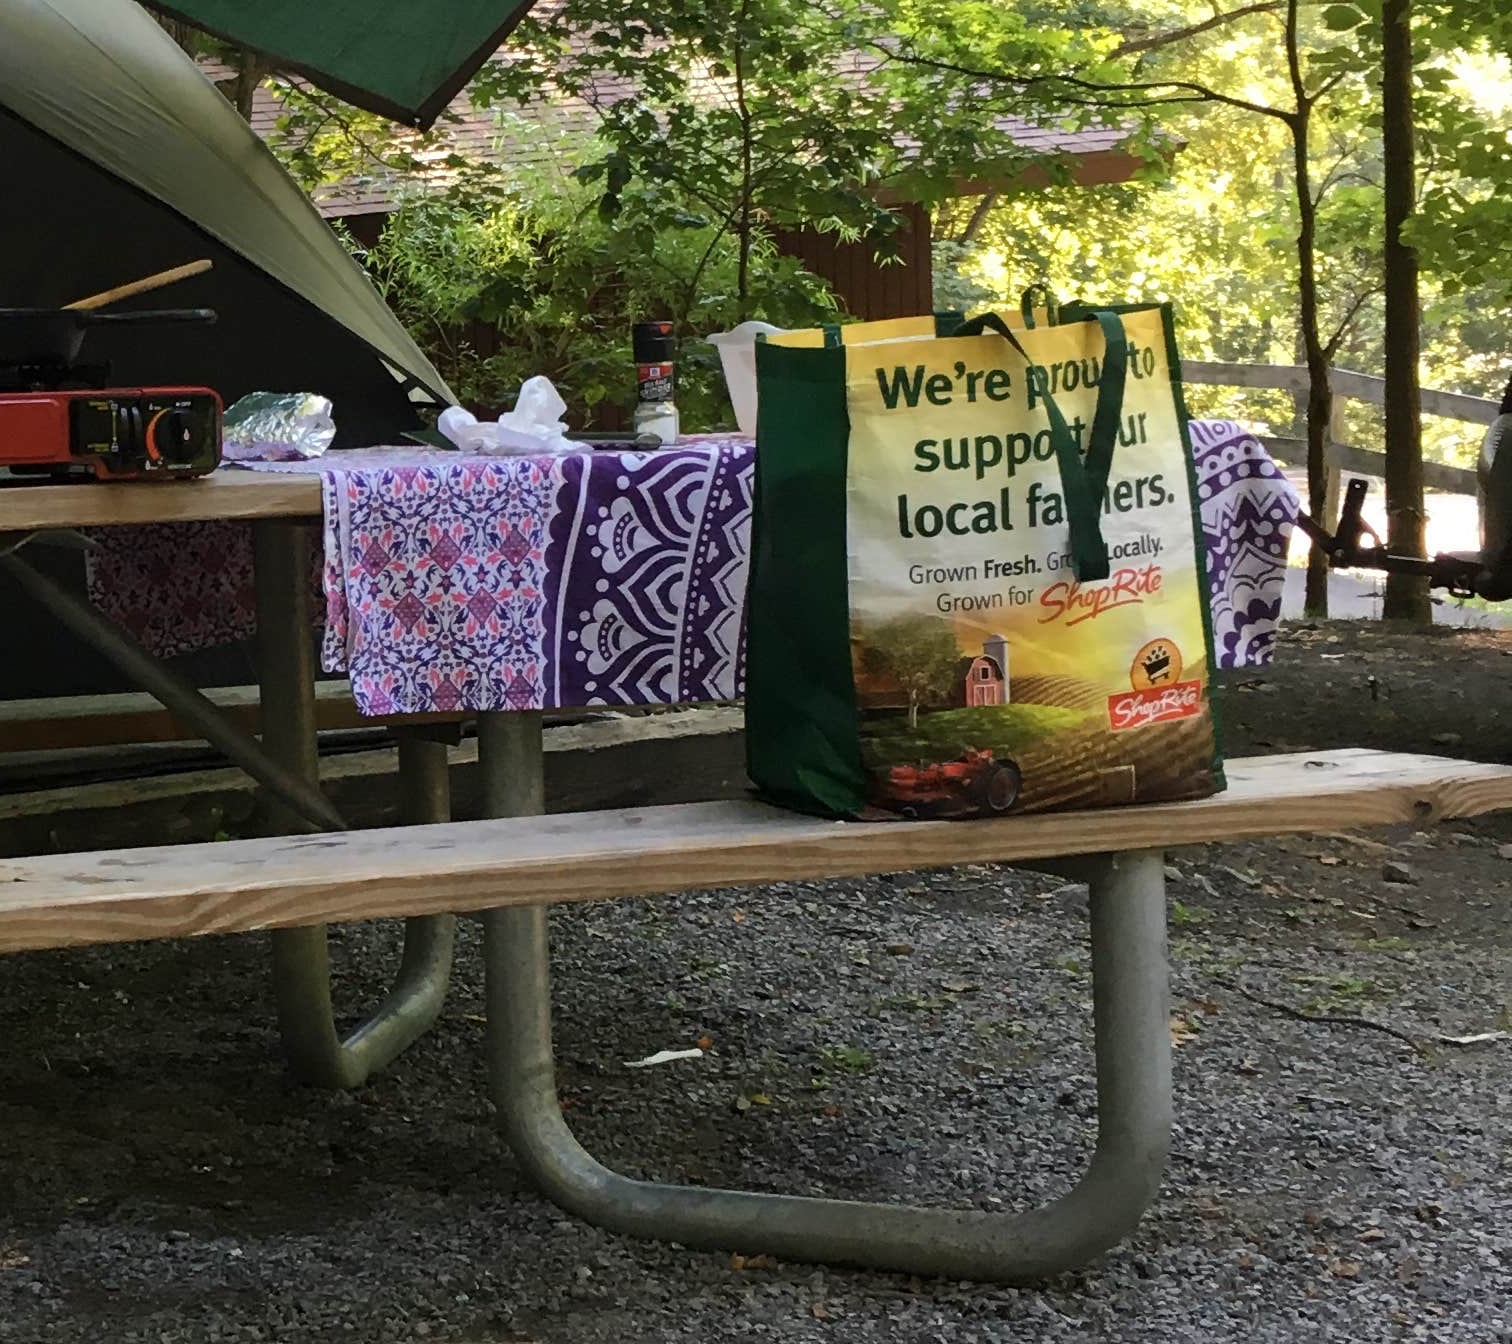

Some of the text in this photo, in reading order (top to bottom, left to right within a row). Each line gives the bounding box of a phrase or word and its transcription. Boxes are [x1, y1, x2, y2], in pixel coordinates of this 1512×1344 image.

[876, 341, 1155, 410] We're prou to
[914, 412, 1147, 480] suppot ur
[898, 474, 1175, 538] local faers.
[909, 564, 977, 584] Grown
[984, 555, 1042, 579] Fresh.
[936, 563, 1163, 626] Grown for ShopRite
[1115, 686, 1198, 727] ShopRite
